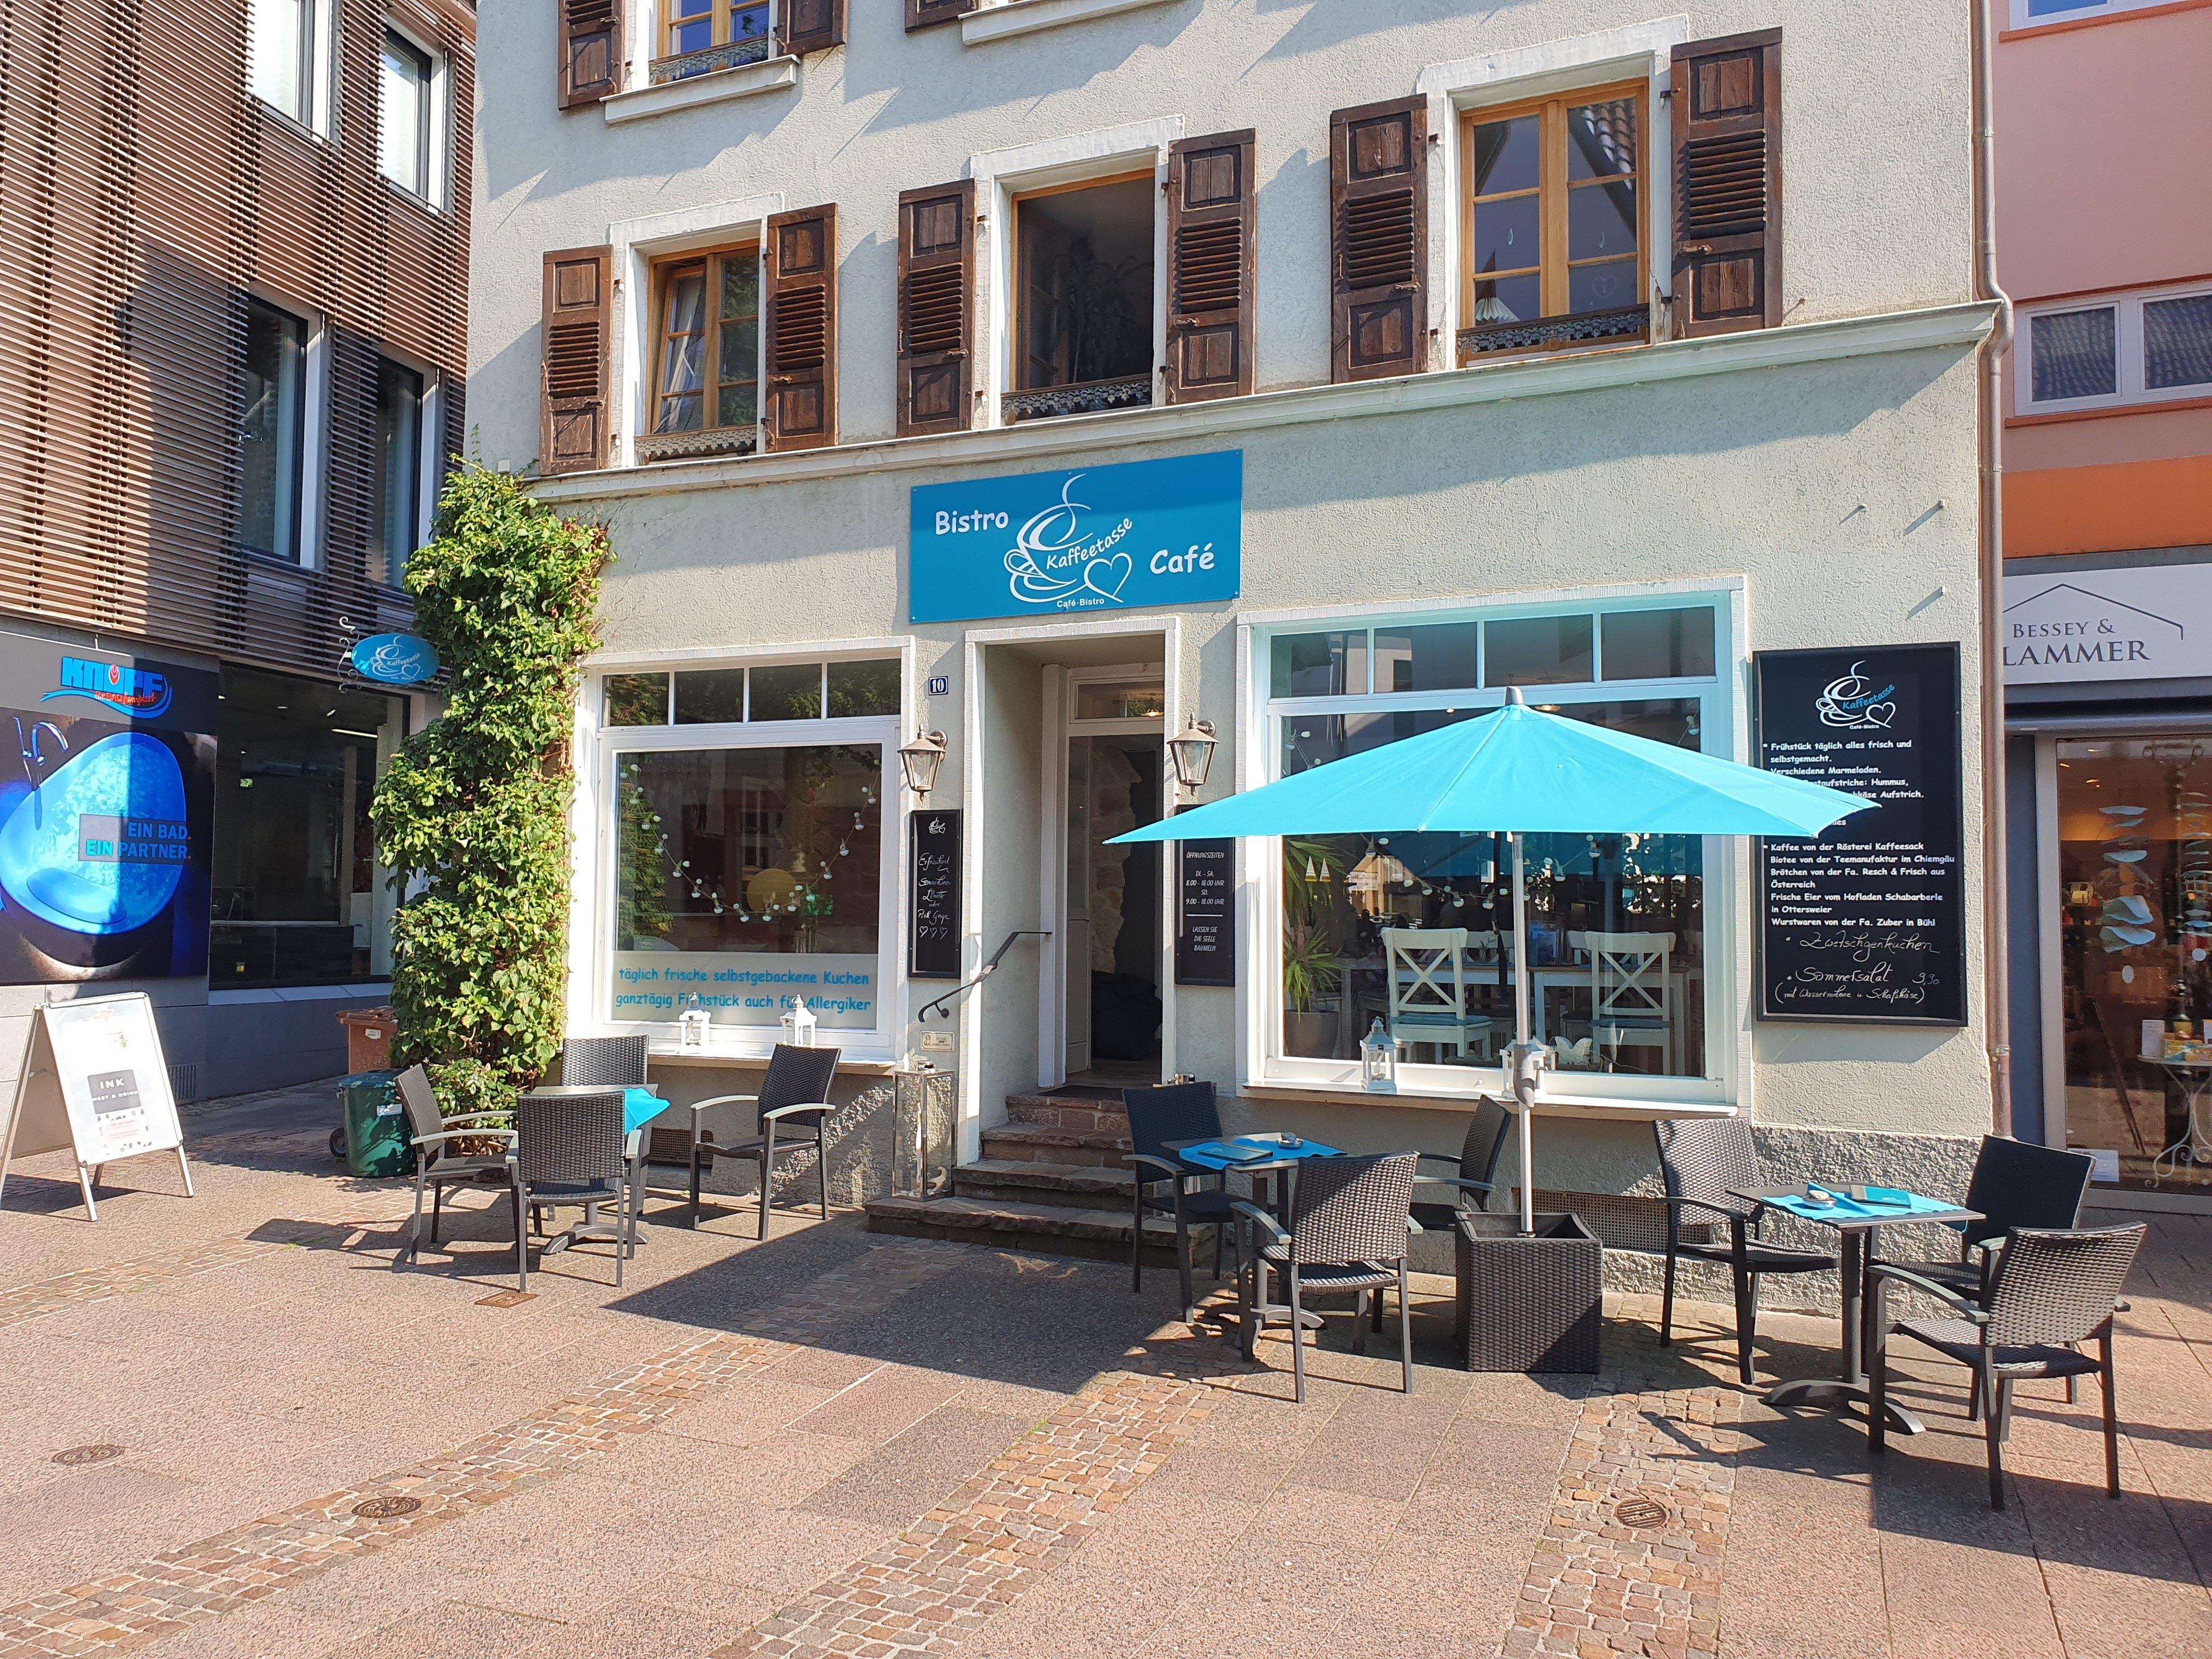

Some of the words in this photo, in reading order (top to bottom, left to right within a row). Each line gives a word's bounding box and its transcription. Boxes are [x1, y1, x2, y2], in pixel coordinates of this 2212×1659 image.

[935, 510, 1009, 535] Bistro
[1046, 518, 1132, 570] Kaffeetasse
[1150, 543, 1215, 574] Café
[2013, 621, 2089, 638] BESSEY
[2097, 618, 2116, 634] &
[932, 679, 944, 692] 10
[1843, 684, 1895, 709] Kaffeetasse
[1771, 742, 1812, 751] Frühstück
[1814, 742, 1842, 751] täglich
[1868, 740, 1893, 749] frisch
[1897, 740, 1912, 748] und
[1770, 754, 1832, 764] selbstgemacht.
[1828, 766, 1881, 774] Marmeladen.
[1871, 778, 1909, 786] Hummus,
[1880, 789, 1924, 798] Aufstrich.
[128, 822, 153, 838] EIN
[86, 839, 113, 856] EIN
[1875, 842, 1924, 850] Kaffeesack
[1833, 855, 1898, 863] Teemanufaktur
[1900, 867, 1927, 876] Frisch
[1771, 879, 1816, 888] Österreich
[1844, 893, 1882, 901] Hofladen
[1859, 918, 1873, 926] Fa.
[1799, 930, 1940, 962] Zwetschgenkuchen
[619, 967, 658, 983] täglich
[664, 967, 707, 981] frische
[713, 968, 817, 986] selbstgebackene
[823, 970, 869, 985] Kuchen
[1796, 961, 1893, 983] Sommersalat
[1912, 972, 1940, 986] 9,90
[616, 992, 673, 1008] ganztägig
[678, 992, 740, 1007] Frhstück
[744, 994, 773, 1008] auch
[780, 994, 796, 1009] fü
[806, 996, 871, 1014] Allergiker
[100, 1078, 125, 1090] INK
